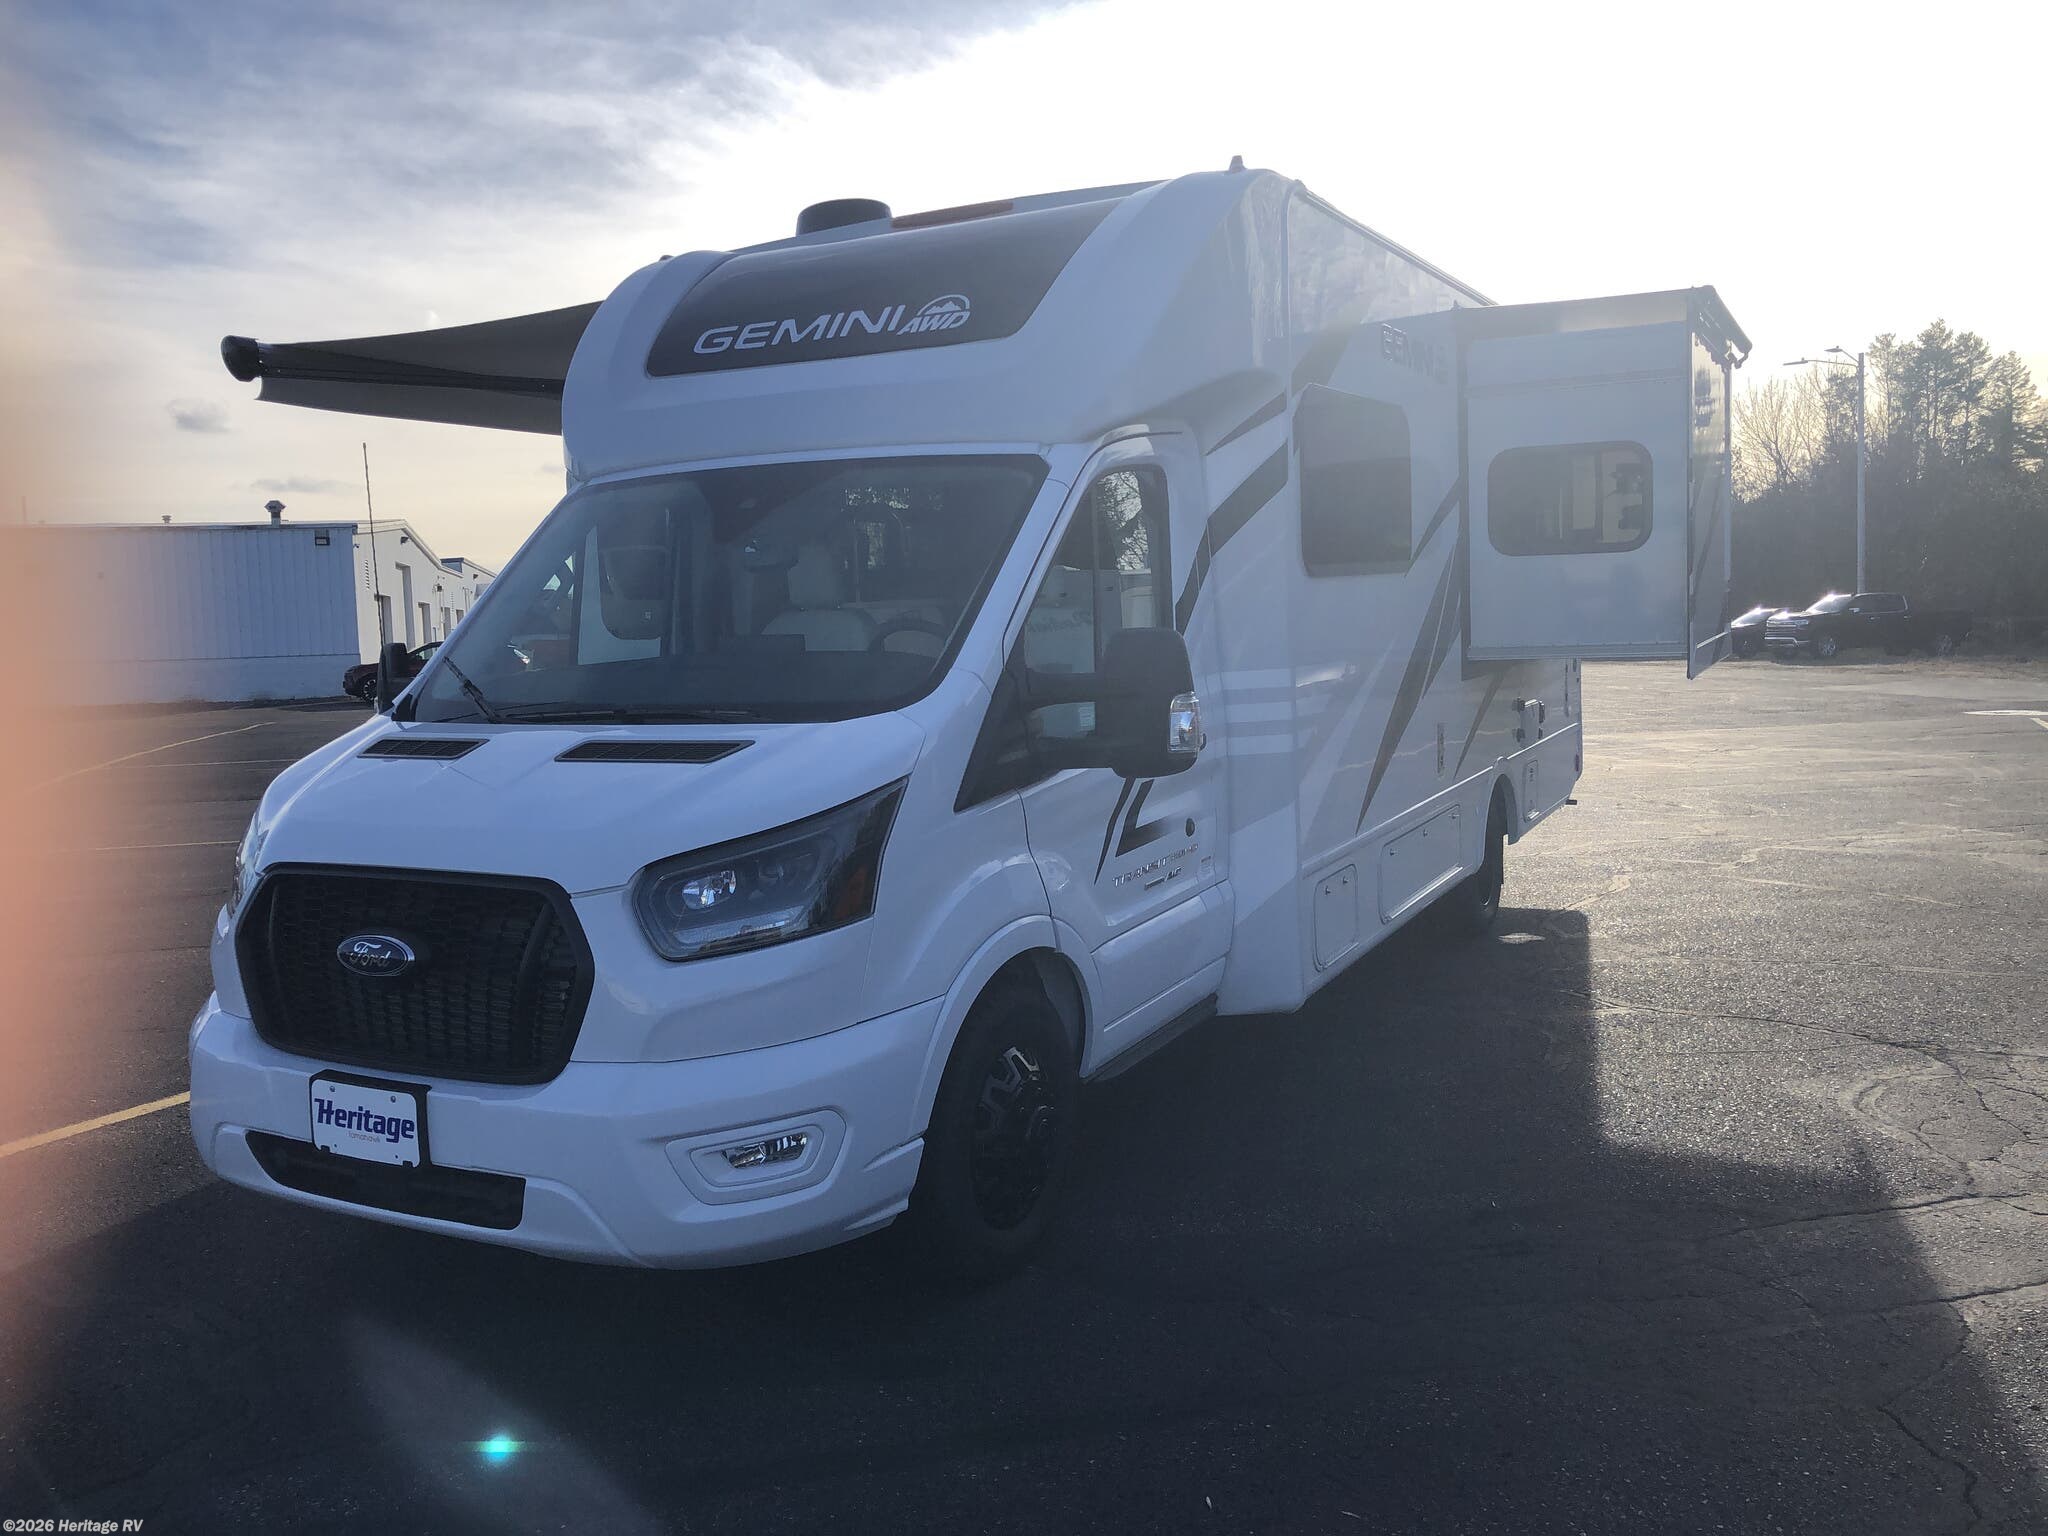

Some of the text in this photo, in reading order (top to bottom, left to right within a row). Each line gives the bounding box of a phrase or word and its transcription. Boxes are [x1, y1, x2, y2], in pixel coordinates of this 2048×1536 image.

[693, 304, 970, 354] GEMINI AWD
[344, 941, 392, 967] Ford
[314, 1098, 415, 1143] Heritage
